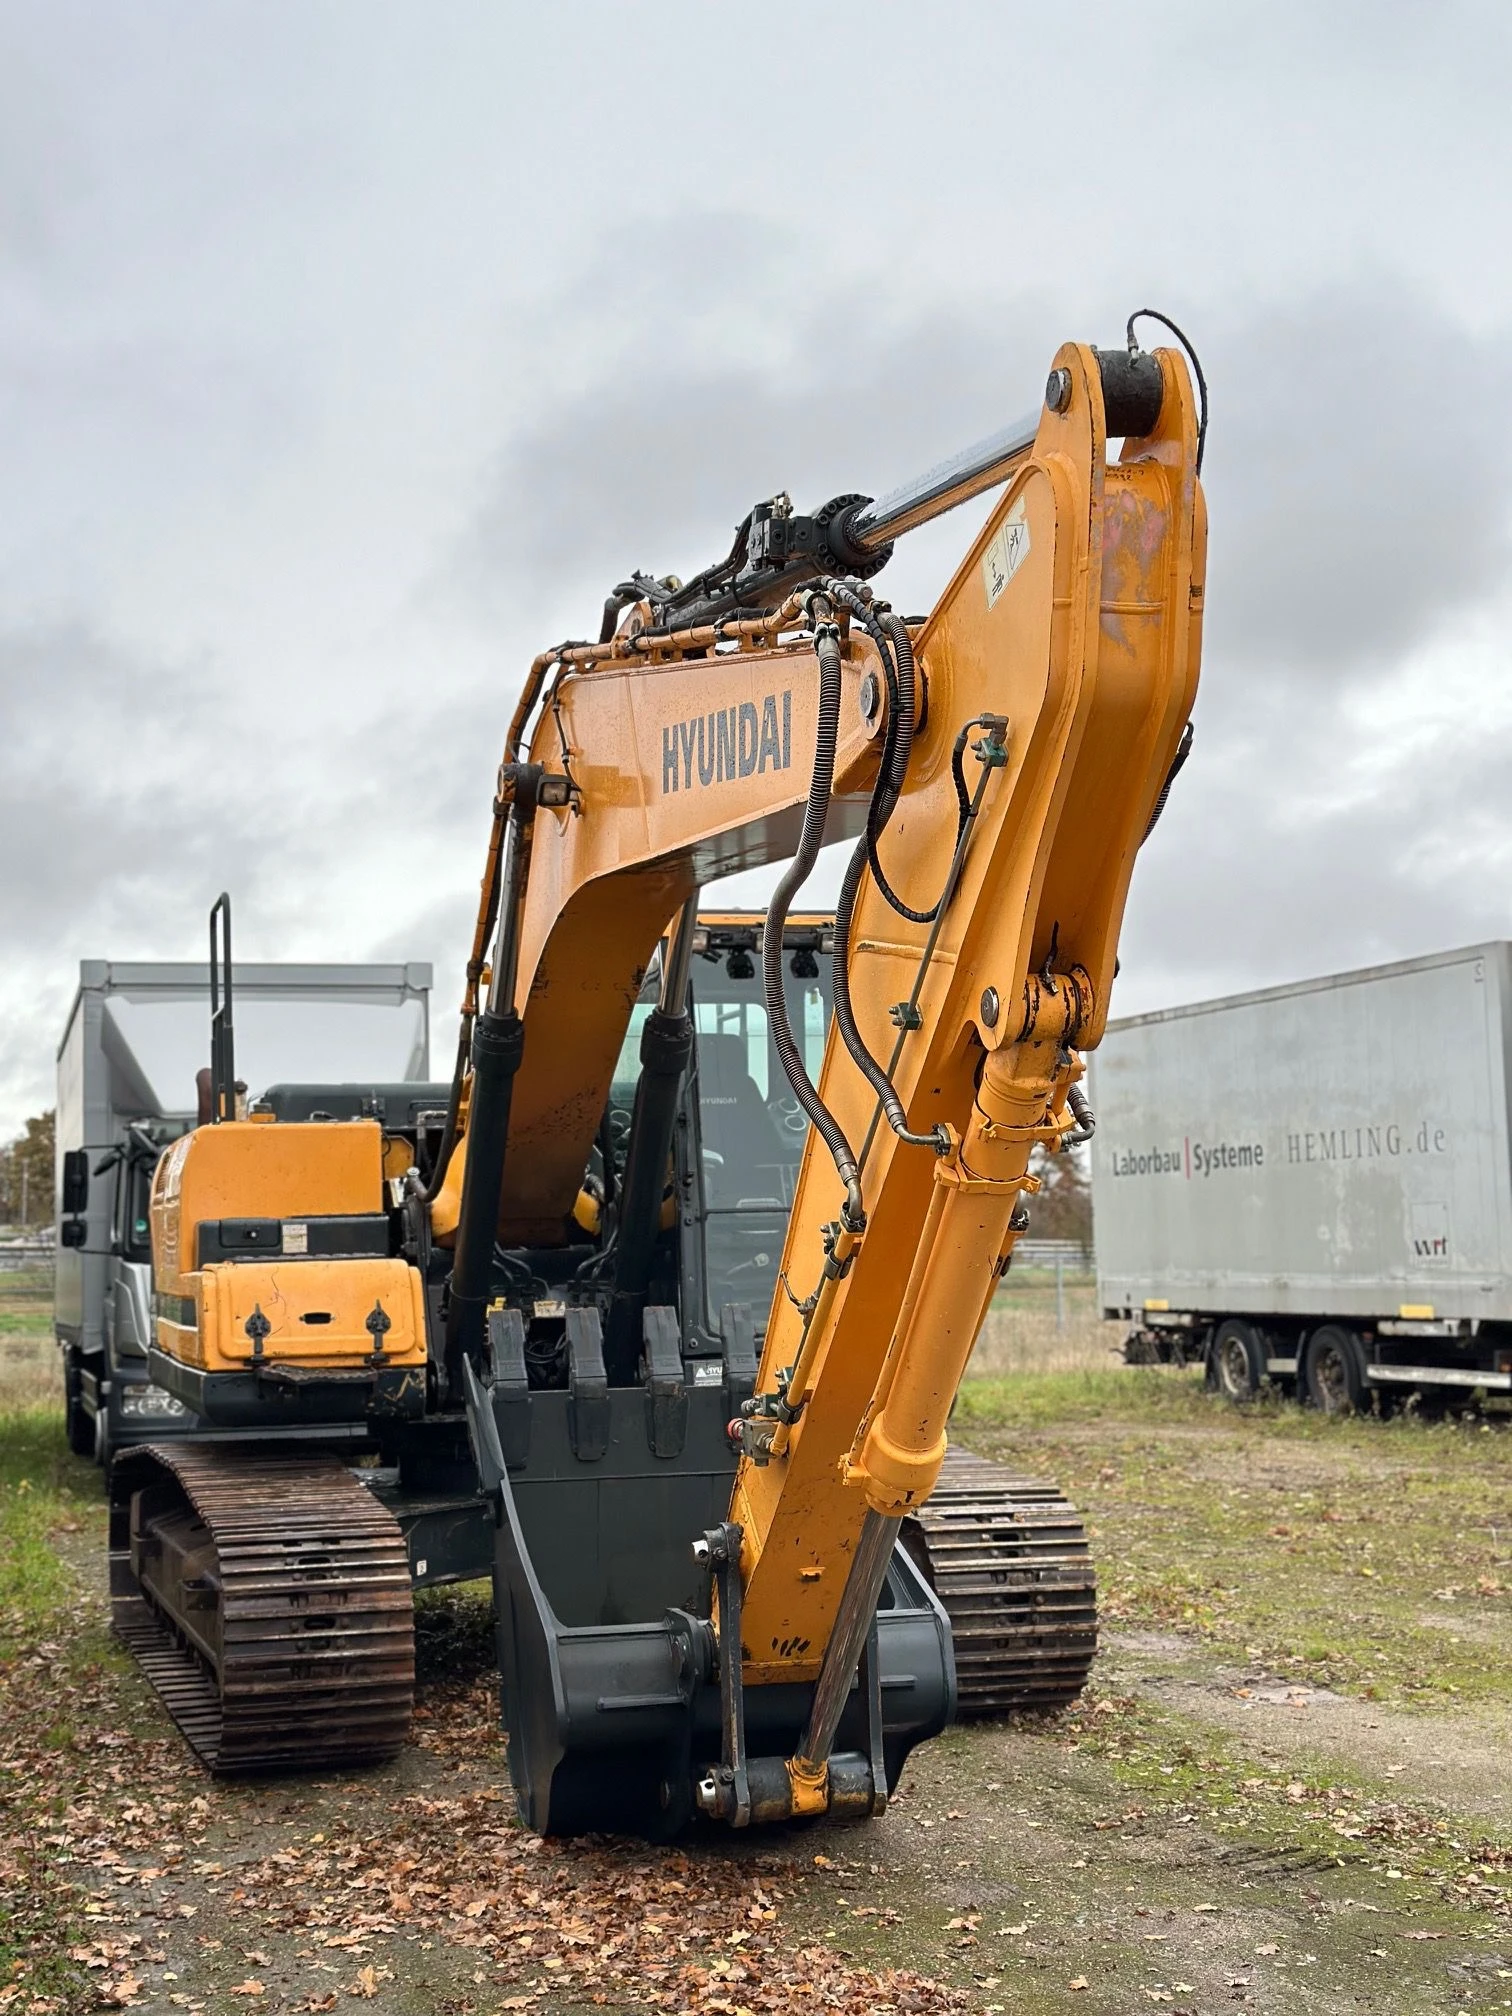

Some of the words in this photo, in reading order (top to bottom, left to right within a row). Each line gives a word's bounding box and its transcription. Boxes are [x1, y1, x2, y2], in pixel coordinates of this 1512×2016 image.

[662, 689, 792, 794] HYUNDAI
[1112, 1145, 1181, 1177] Laborbau
[1193, 1143, 1264, 1178] Systeme
[1287, 1121, 1445, 1164] HEMLING.de
